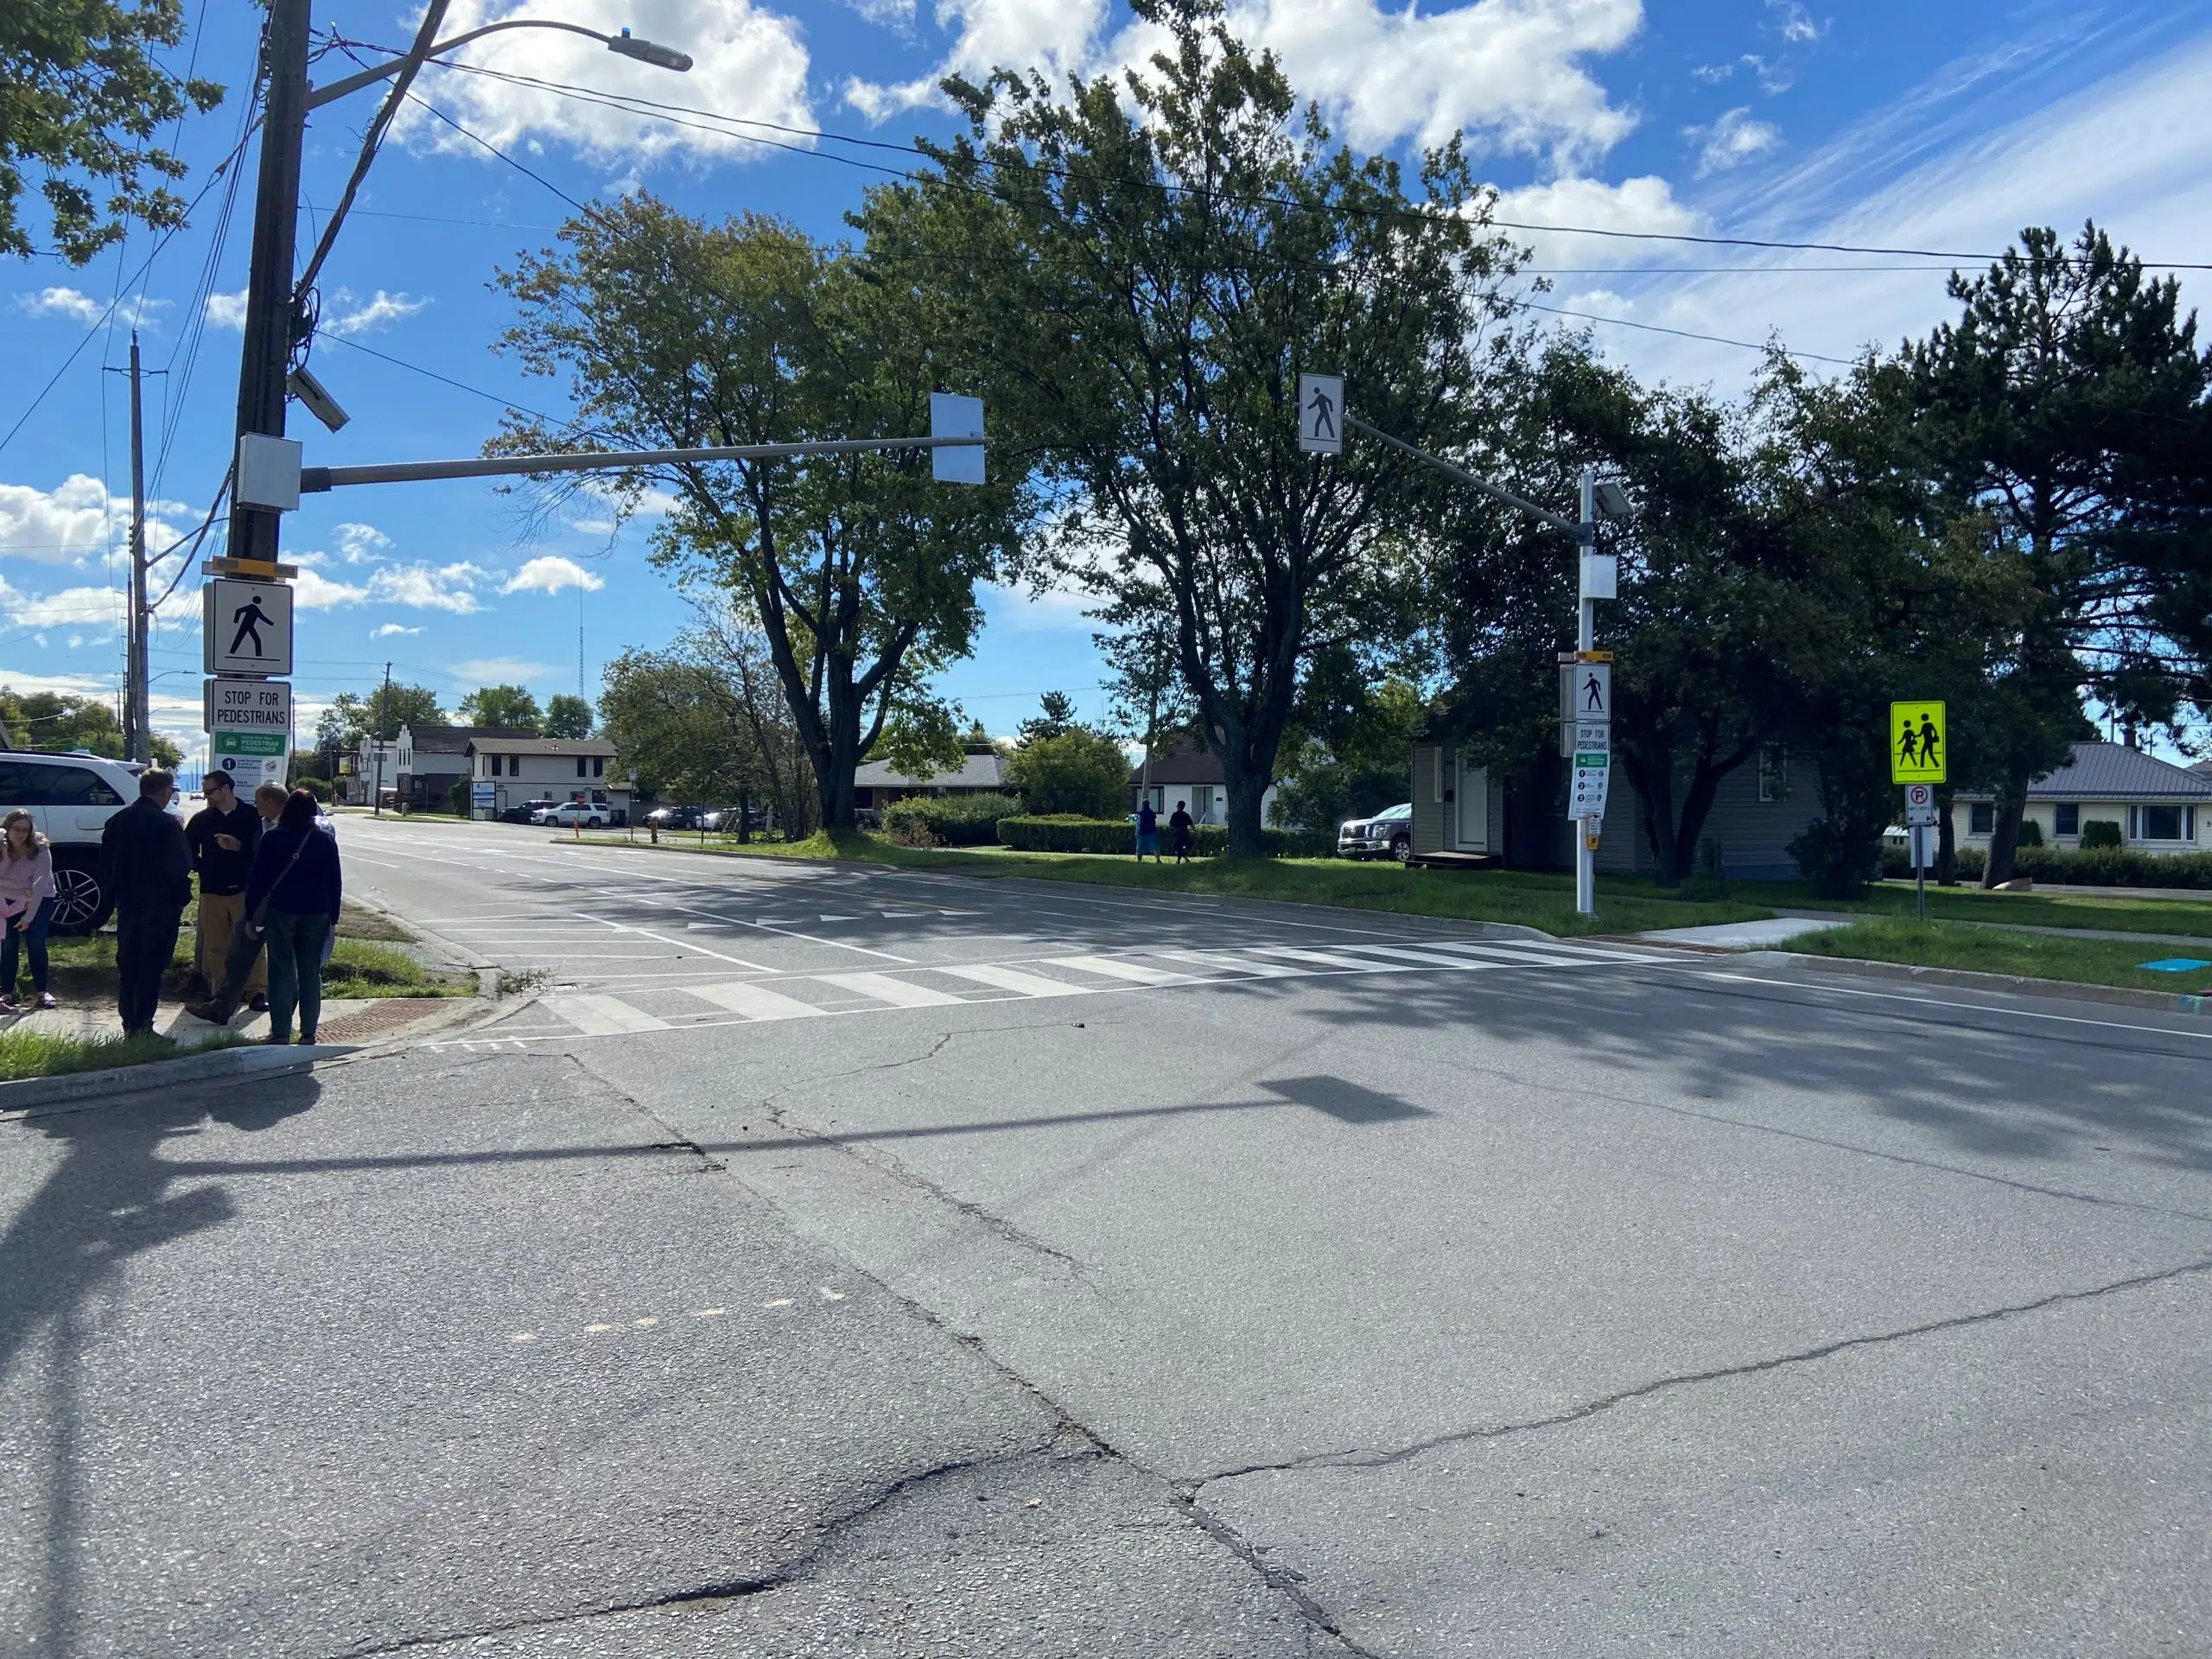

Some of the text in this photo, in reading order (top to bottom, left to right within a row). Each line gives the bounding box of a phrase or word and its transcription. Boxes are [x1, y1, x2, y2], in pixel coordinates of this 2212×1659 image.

[225, 690, 279, 706] STOP FOR
[217, 709, 285, 724] PEDESTRIANS
[1580, 729, 1605, 739] STOP FOR
[241, 739, 279, 747] PEDESTRIAN
[1577, 741, 1607, 750] PEDESTRIANS
